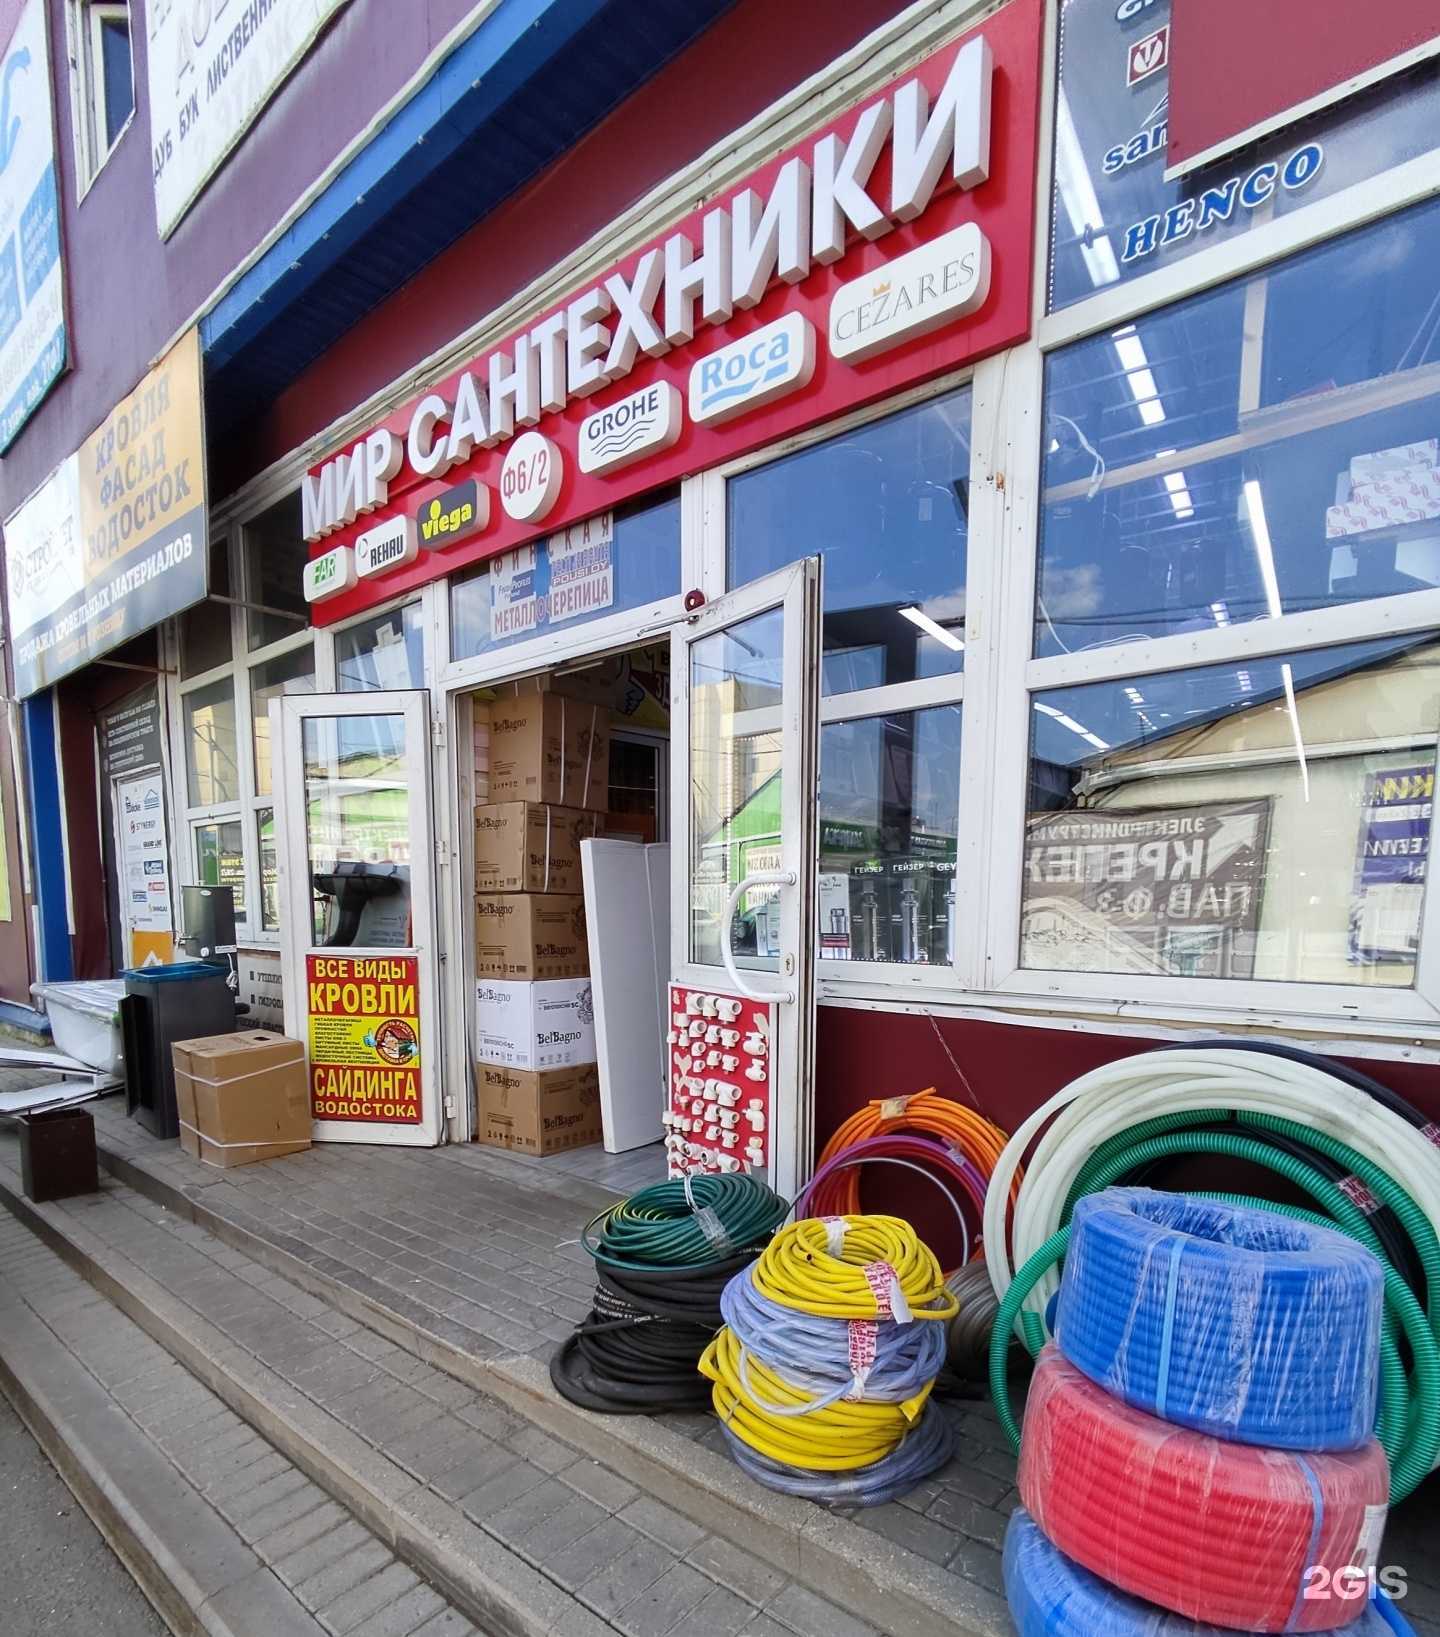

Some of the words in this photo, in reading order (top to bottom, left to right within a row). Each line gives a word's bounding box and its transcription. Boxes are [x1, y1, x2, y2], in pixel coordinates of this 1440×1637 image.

[179, 87, 200, 141] БУК
[206, 0, 277, 103] ЛИСТВЕНН
[1121, 141, 1324, 262] HENCO
[302, 428, 402, 543] МИР
[408, 34, 993, 476] САНТЕХНИКИ
[834, 251, 976, 343] CEZARES
[701, 331, 790, 394] Roca
[95, 372, 171, 474] КРОВЛЯ
[588, 389, 660, 440] GROHE
[100, 429, 166, 509] ФАСАД
[502, 448, 549, 500] Ф6/2
[88, 458, 191, 563] ВОДОСТОК
[420, 499, 473, 540] viega
[111, 532, 193, 602] МАТЕРИАЛОВ
[370, 533, 404, 567] REHAU
[313, 554, 337, 585] FAR
[495, 575, 609, 634] МЕТАЛЛОЧЕРЕПИЦА
[493, 718, 528, 732] BelBagno
[475, 817, 508, 829] BelBagno
[893, 862, 924, 872] ГЕЙЗЕР
[477, 903, 514, 916] BelBagno
[535, 943, 577, 957] BelBagno
[315, 960, 348, 979] ВСЕ
[354, 960, 406, 982] ВИДЫ
[310, 983, 415, 1014] КРОВЛИ
[477, 987, 511, 1003] BelBagno
[536, 1030, 582, 1045] BelBagno
[314, 1065, 418, 1101] САЙДИНГА
[485, 1070, 521, 1089] BelBagno
[315, 1100, 417, 1118] ВОДОСТОКА
[543, 1111, 584, 1131] BelBagno
